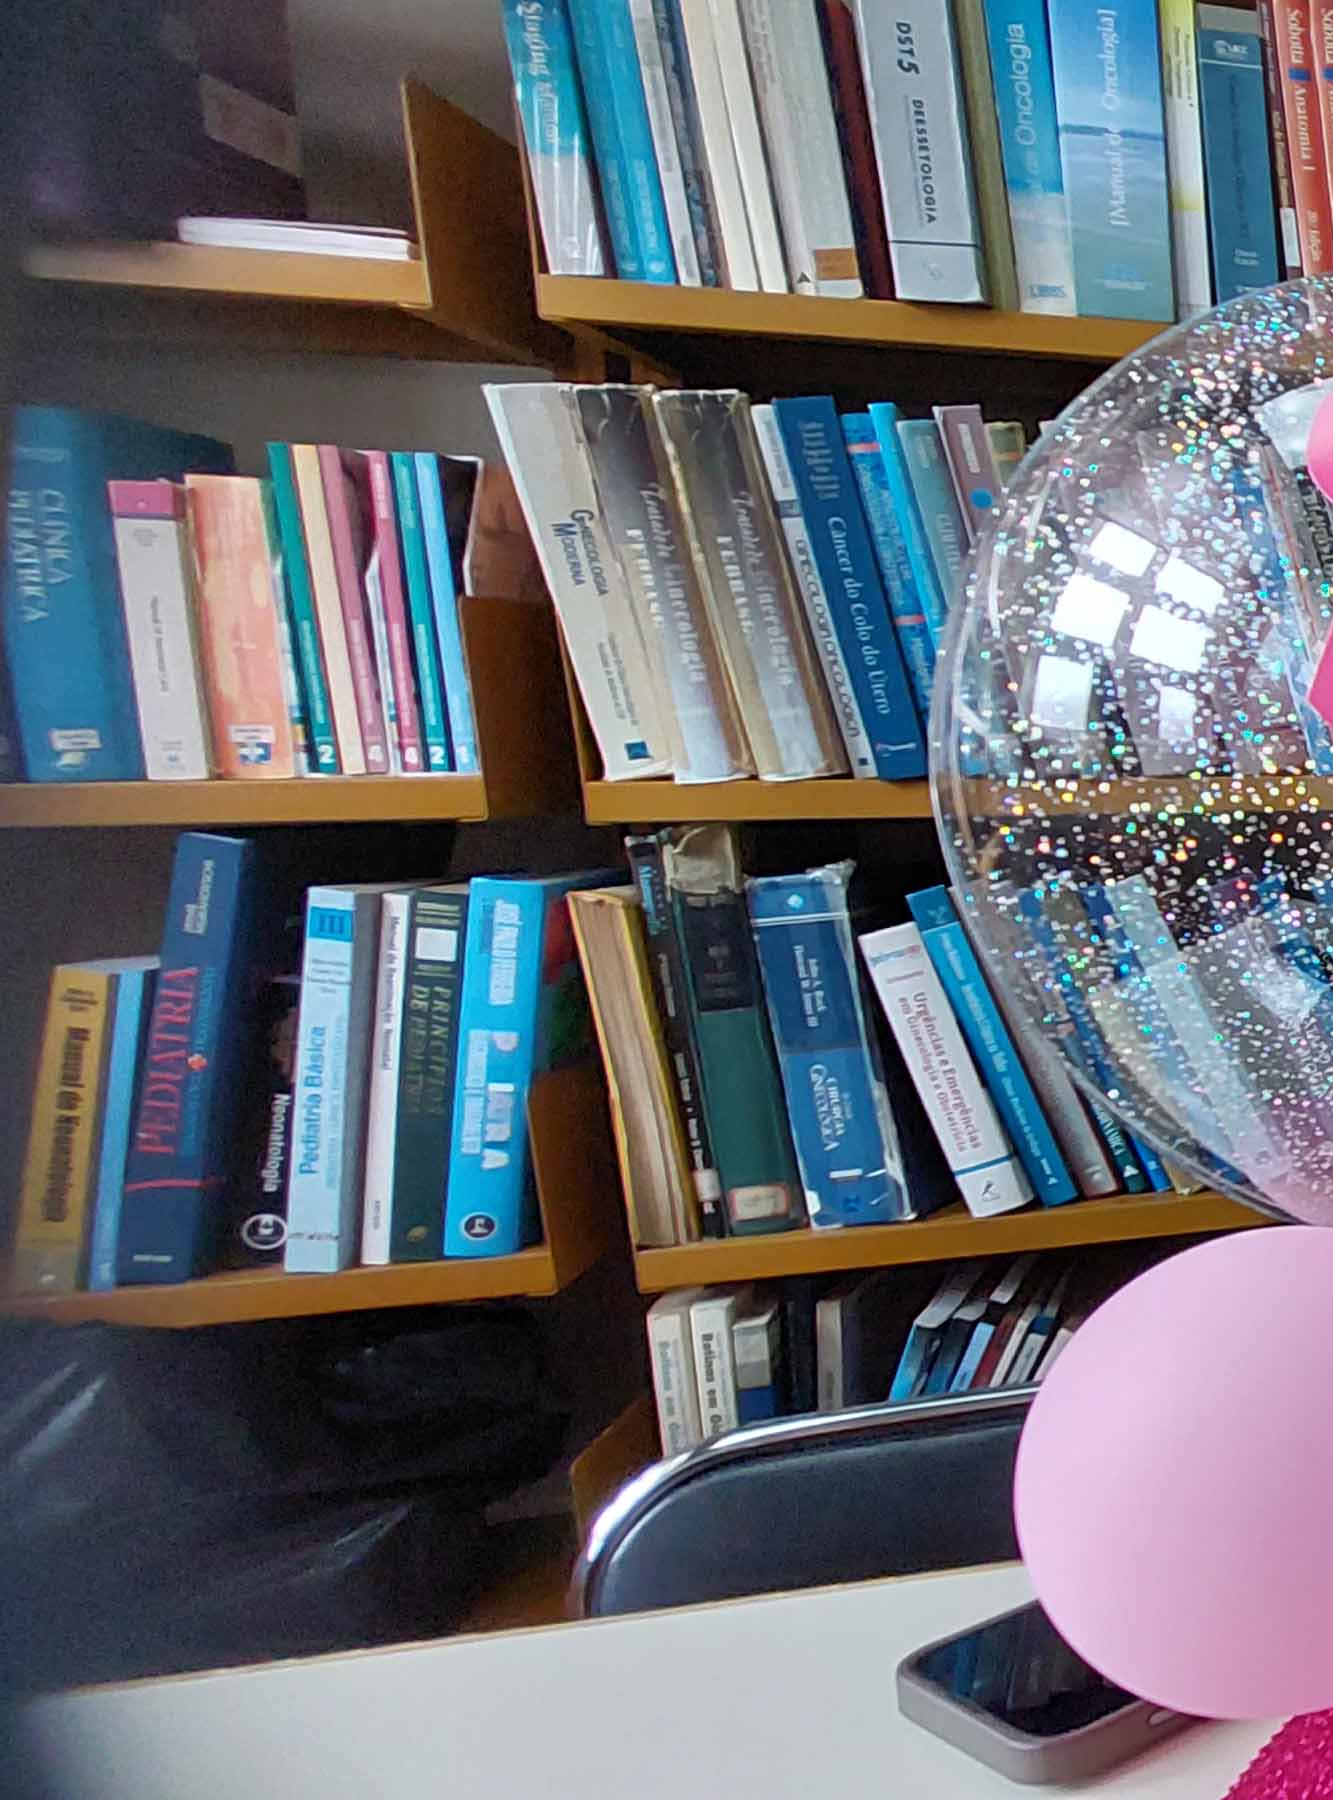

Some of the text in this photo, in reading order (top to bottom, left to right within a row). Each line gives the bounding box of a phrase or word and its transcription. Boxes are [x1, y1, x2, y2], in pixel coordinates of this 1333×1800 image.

[896, 21, 920, 76] DST 5
[1286, 8, 1305, 64] Sobotta
[1006, 23, 1039, 146] Oncologia
[1295, 87, 1312, 160] Anatomia
[911, 98, 936, 224] DEESSETOLOGIA
[551, 522, 586, 588] MODERNA
[845, 578, 864, 599] do
[851, 602, 870, 641] Colo
[863, 645, 880, 665] do
[318, 743, 335, 764] 2
[430, 746, 446, 765] 2
[410, 984, 432, 1013] DE
[137, 967, 200, 1155] PEDIATRIA
[913, 992, 946, 1055] Urgências
[943, 1069, 982, 1149] Emergências
[299, 1025, 327, 1175] Pediatria Básica
[262, 1093, 291, 1193] Neonatologia
